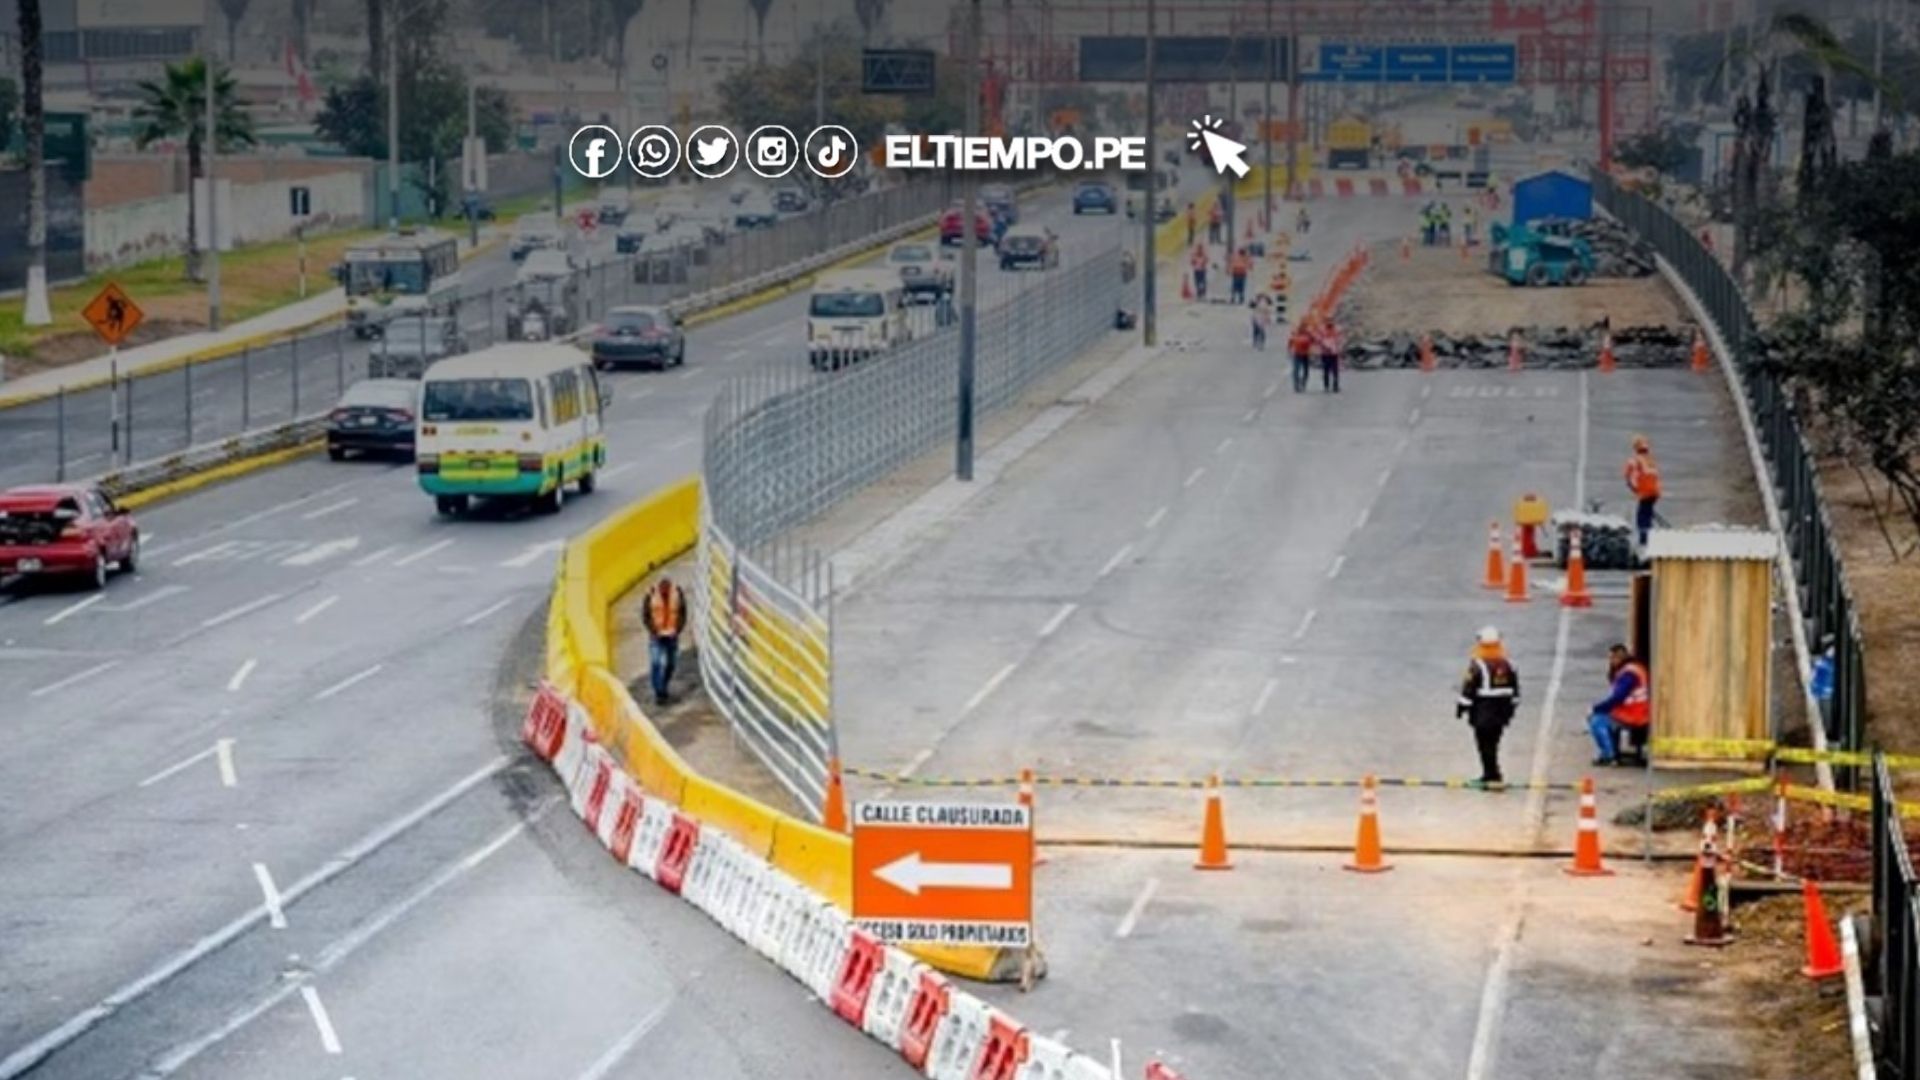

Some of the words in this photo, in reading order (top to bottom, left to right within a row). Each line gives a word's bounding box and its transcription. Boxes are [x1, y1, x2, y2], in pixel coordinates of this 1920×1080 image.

[861, 804, 912, 823] CALLE
[916, 805, 1025, 826] CLAUSURADA
[857, 921, 902, 940] CCESO
[908, 922, 938, 941] SOLO
